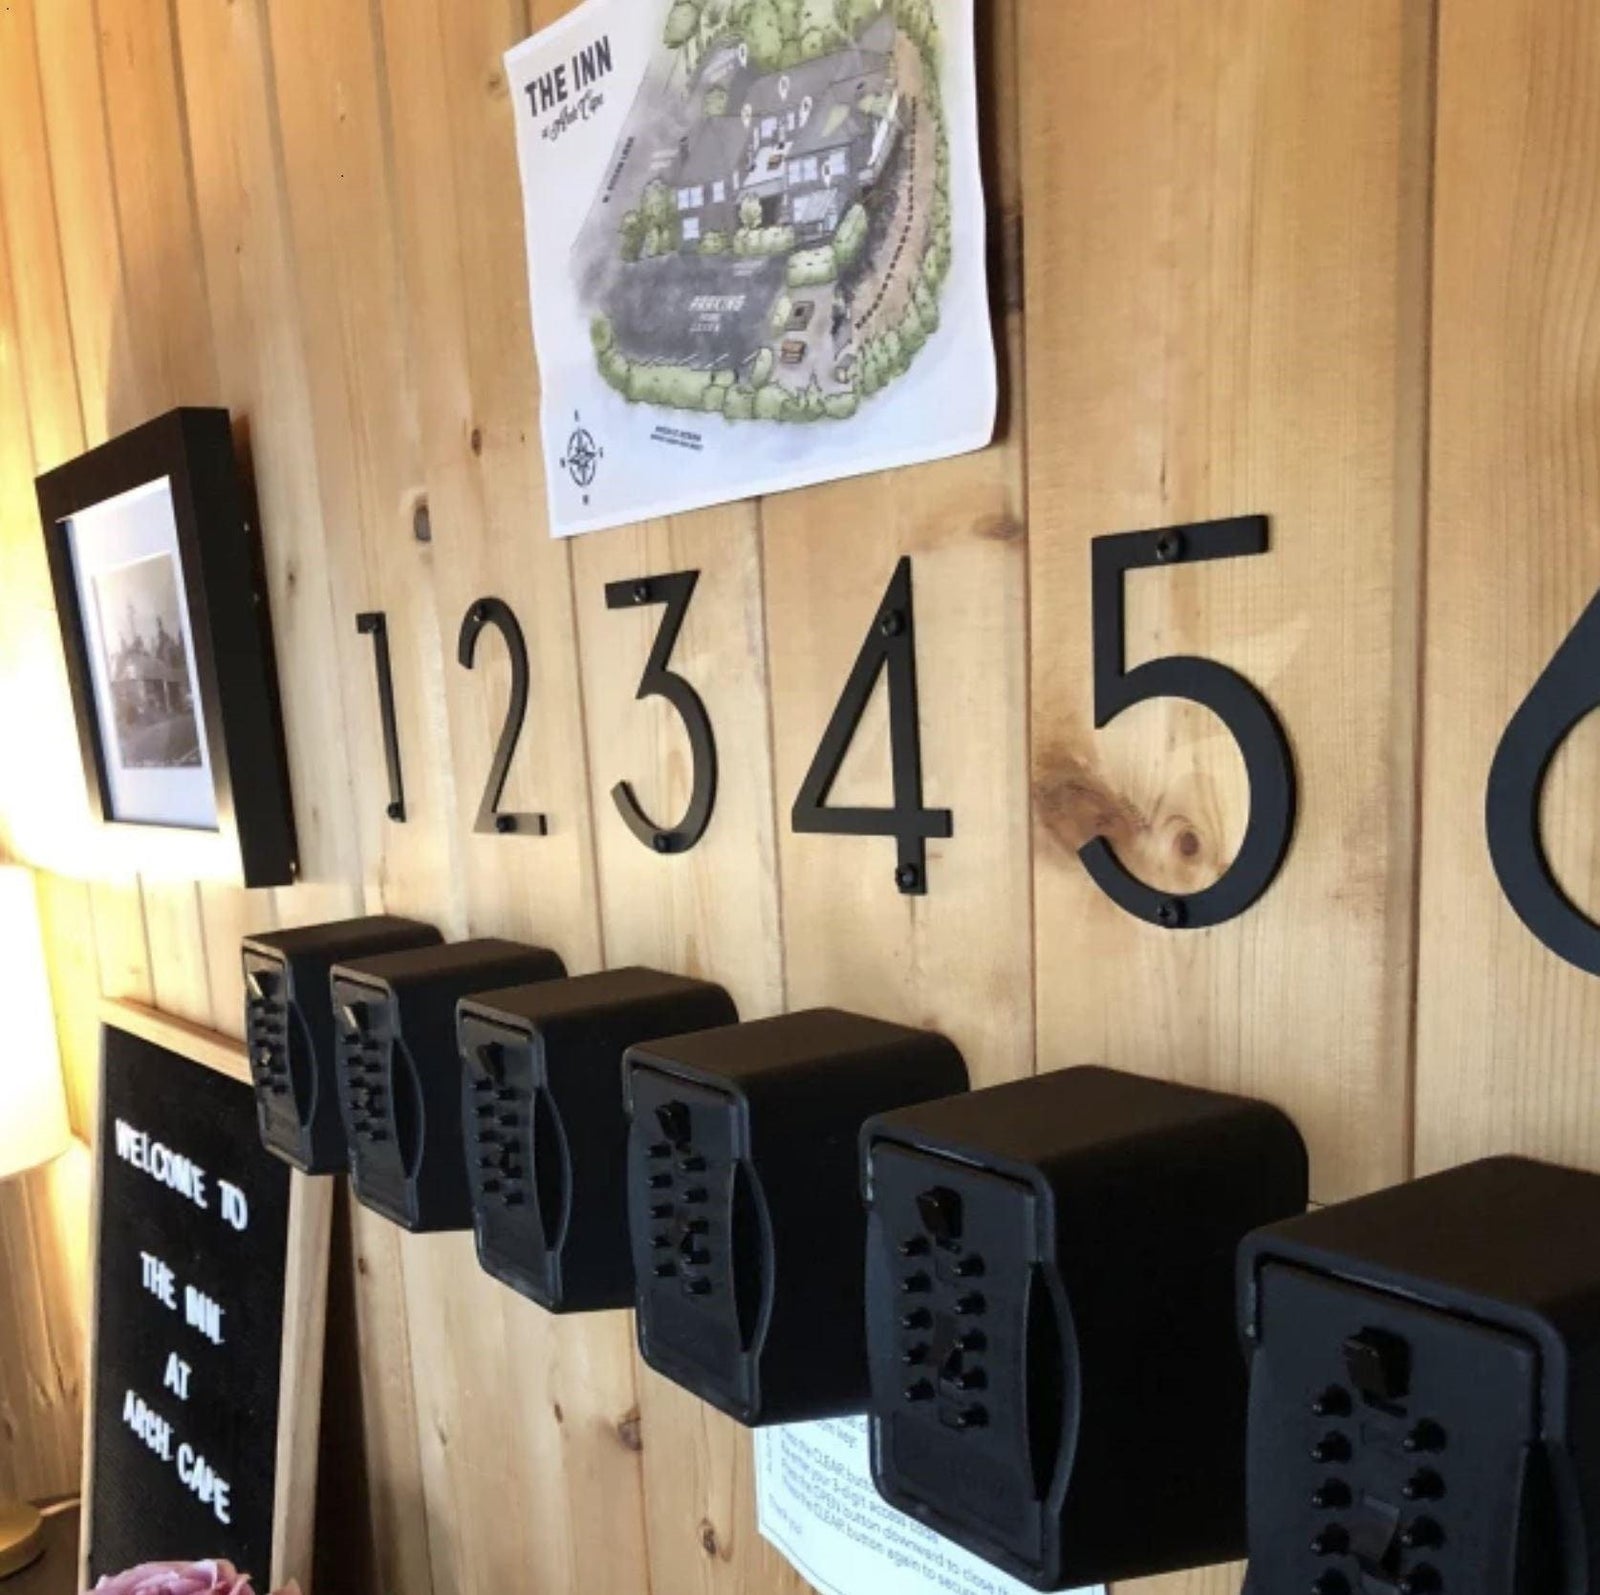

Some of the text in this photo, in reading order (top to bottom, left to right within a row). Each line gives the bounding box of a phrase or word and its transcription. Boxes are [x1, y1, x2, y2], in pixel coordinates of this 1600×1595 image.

[525, 35, 612, 117] THE INN
[356, 612, 406, 823] 1
[457, 597, 548, 836] 2
[604, 569, 720, 855] 3
[791, 555, 953, 895] 4
[1077, 514, 1297, 929] 5
[115, 1117, 248, 1231] WELCOME TO
[140, 1251, 225, 1345] THE INN
[122, 1388, 174, 1461] ARCH
[163, 1351, 192, 1400] AT
[813, 1447, 845, 1475] CLEAR
[813, 1502, 846, 1533] CLEAR
